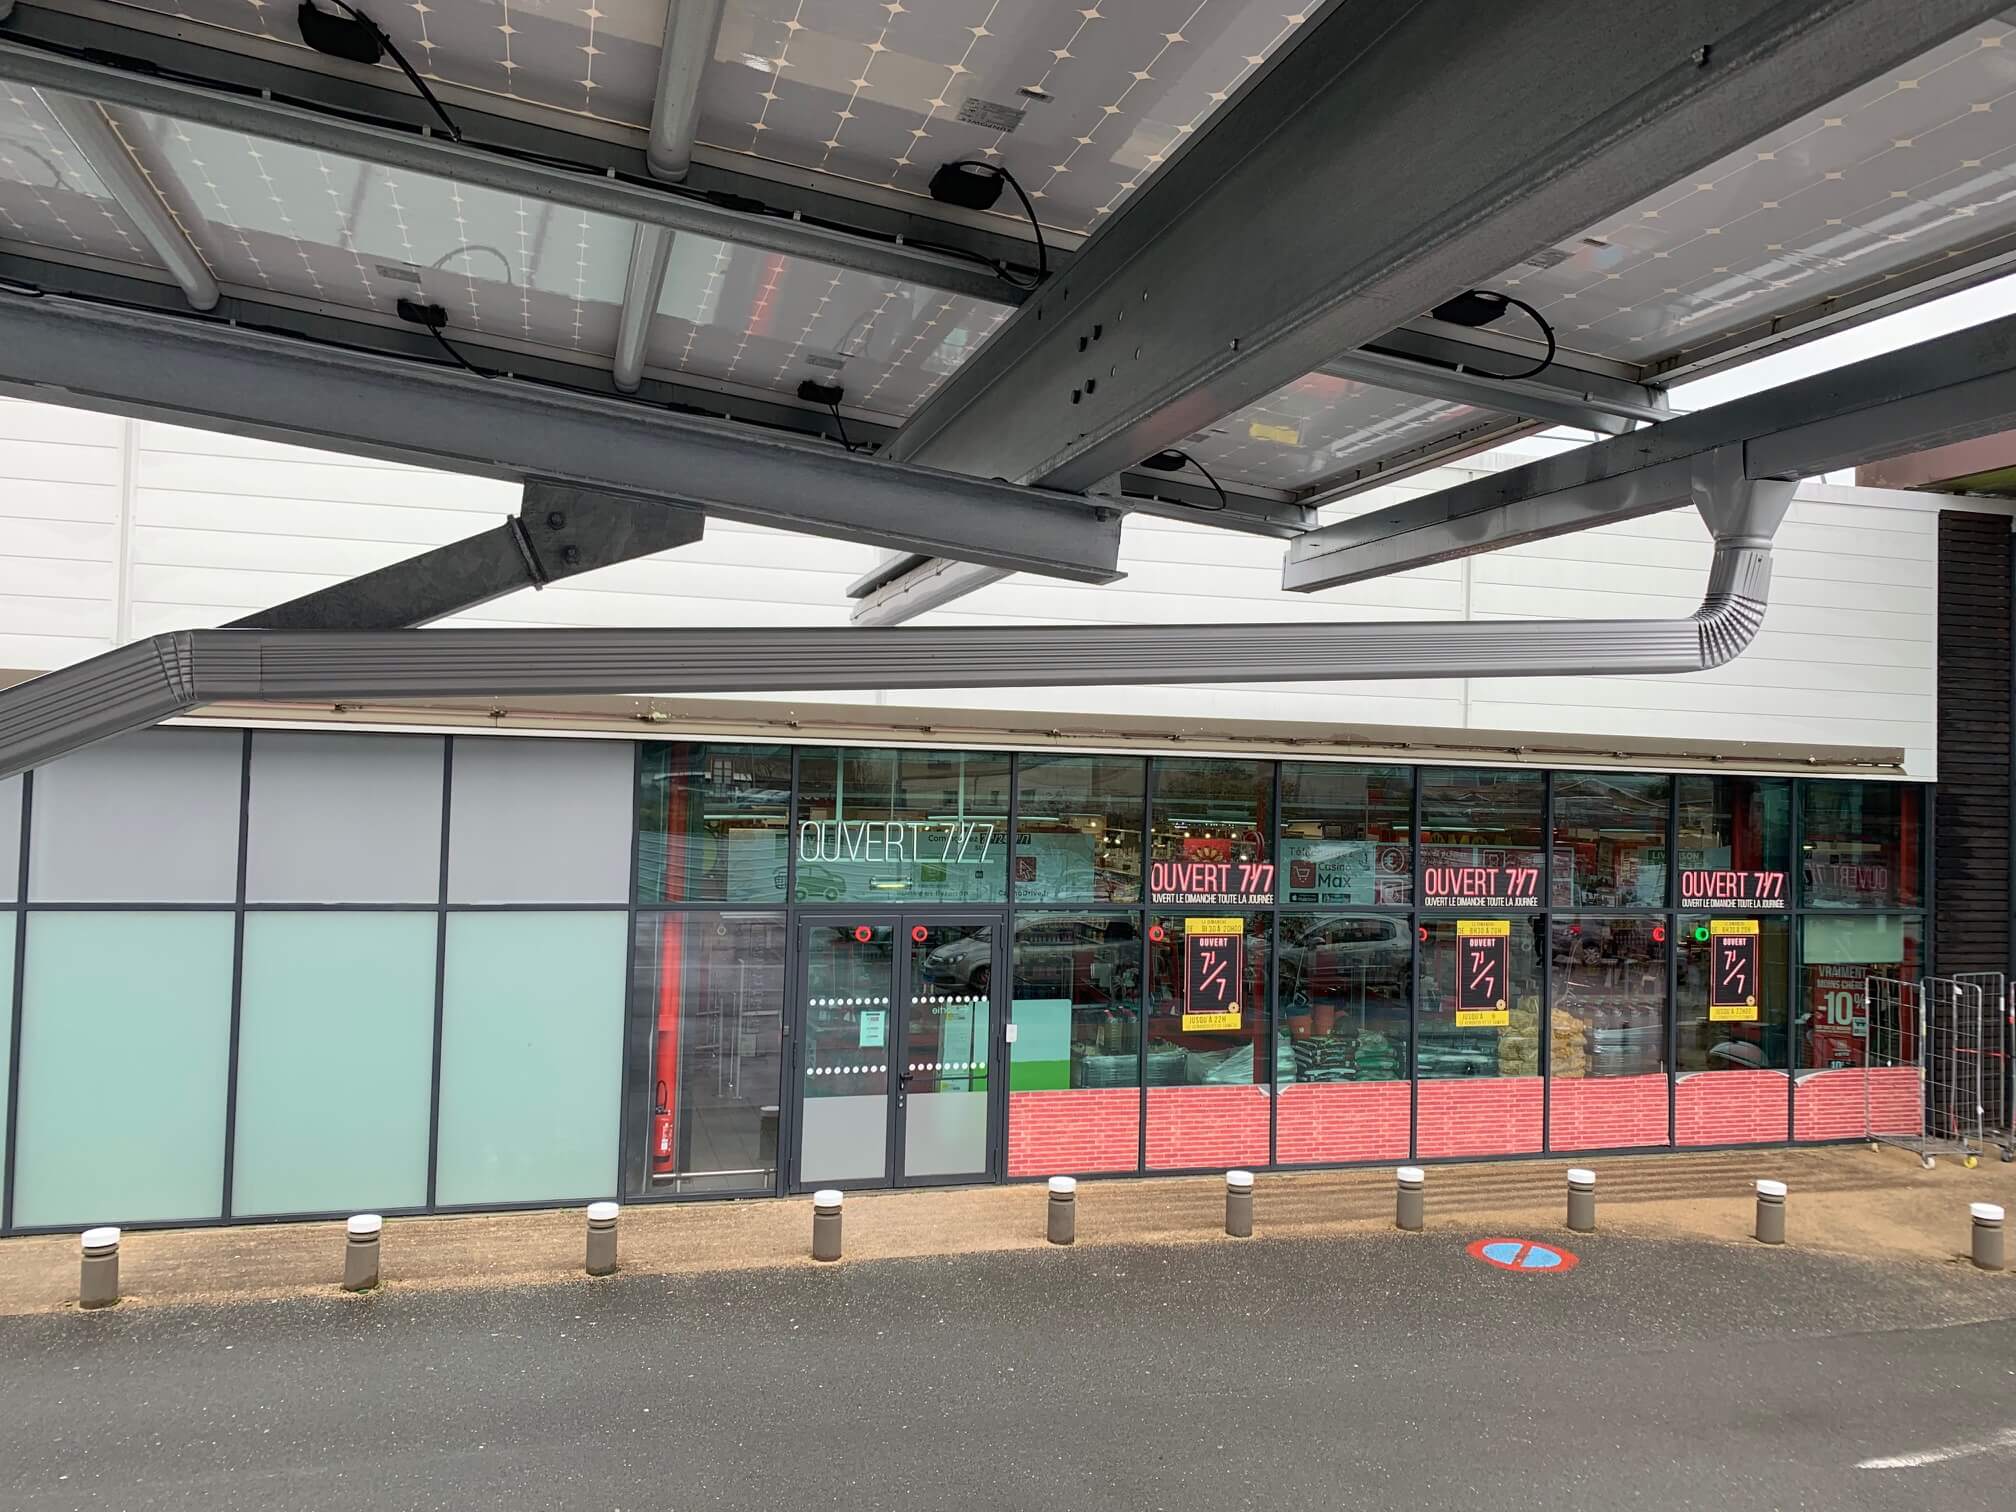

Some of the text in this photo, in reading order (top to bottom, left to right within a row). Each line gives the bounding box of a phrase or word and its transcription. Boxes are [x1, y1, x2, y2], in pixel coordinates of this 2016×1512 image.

[800, 821, 924, 863] OUVERT
[1318, 863, 1352, 872] Casino
[1151, 863, 1231, 893] OUVERT
[1318, 873, 1352, 888] Max
[1425, 868, 1499, 896] OUVERT
[1682, 871, 1748, 897] OUVERT
[1176, 893, 1184, 903] LE
[1185, 893, 1217, 904] DIMANCHE
[1218, 894, 1237, 904] TOUTE
[1238, 894, 1247, 904] LA
[1248, 893, 1274, 904] JOURNÉE
[1425, 895, 1538, 906] OUVERT LE DIMANCHE TOUTE LA JOURNÉE
[1682, 899, 1703, 908] OUVERT
[1703, 899, 1710, 908] LE
[1711, 899, 1737, 908] DIMANCHE
[1737, 899, 1753, 908] TOUTE
[1753, 899, 1761, 908] LA
[1199, 937, 1228, 946] OUVERT
[1469, 938, 1496, 947] OUVERT
[1722, 937, 1746, 946] OUVERT
[1818, 965, 1866, 979] VRAIMENT
